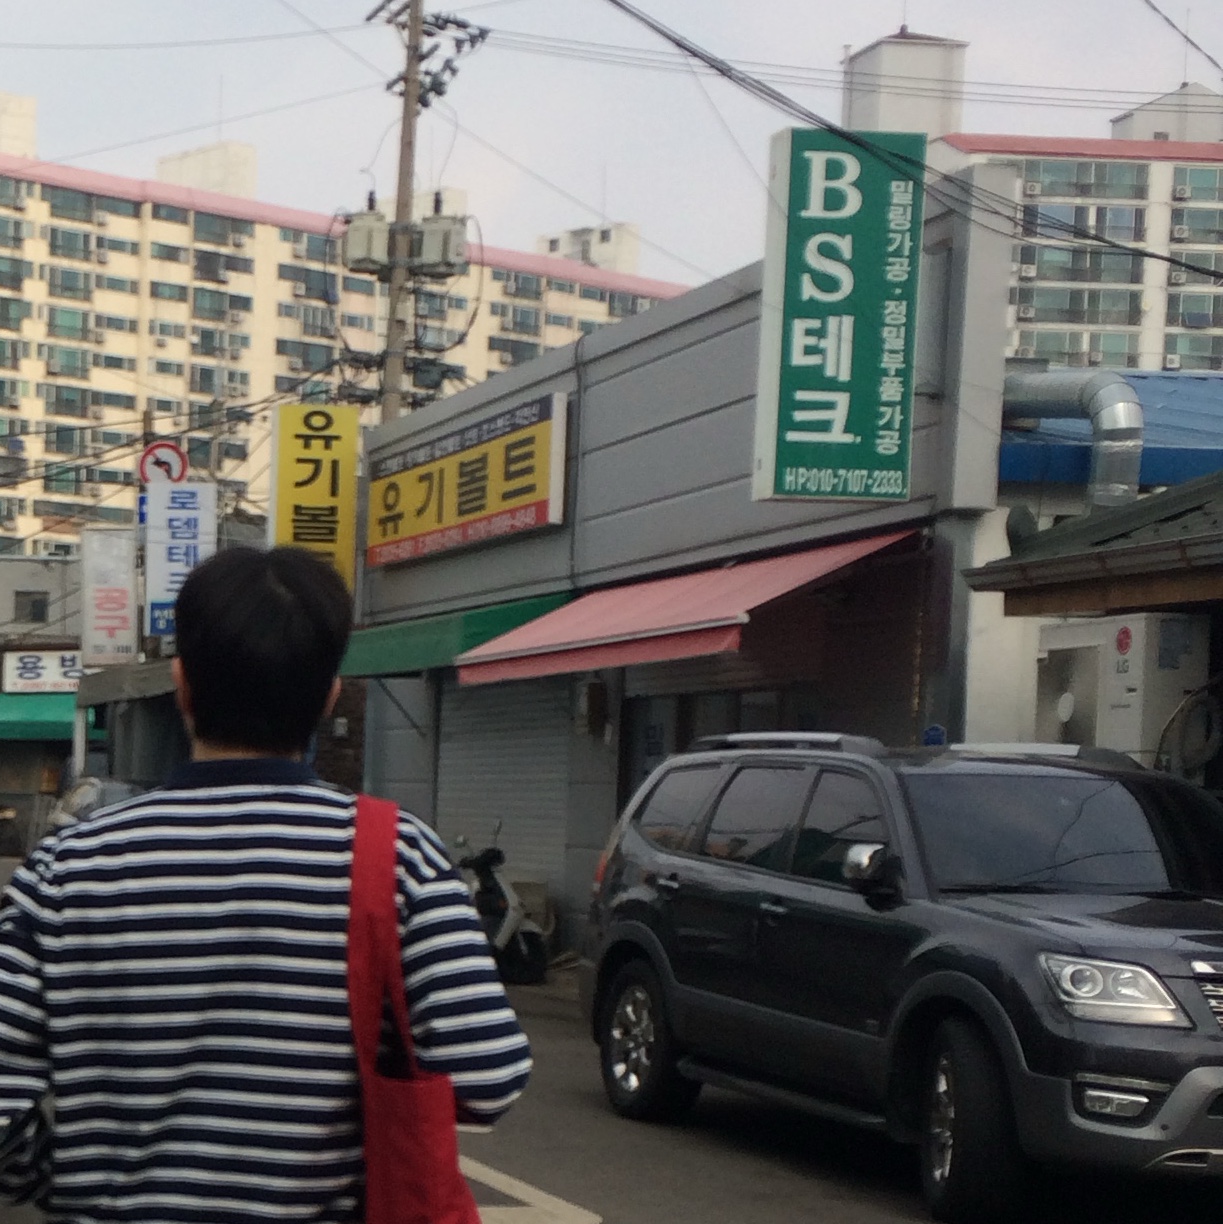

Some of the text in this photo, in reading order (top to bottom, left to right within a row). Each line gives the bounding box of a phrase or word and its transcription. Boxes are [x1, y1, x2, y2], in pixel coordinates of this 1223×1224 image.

[785, 149, 864, 444] BS테크
[291, 410, 343, 564] 유기볼
[375, 434, 538, 538] 유기볼트
